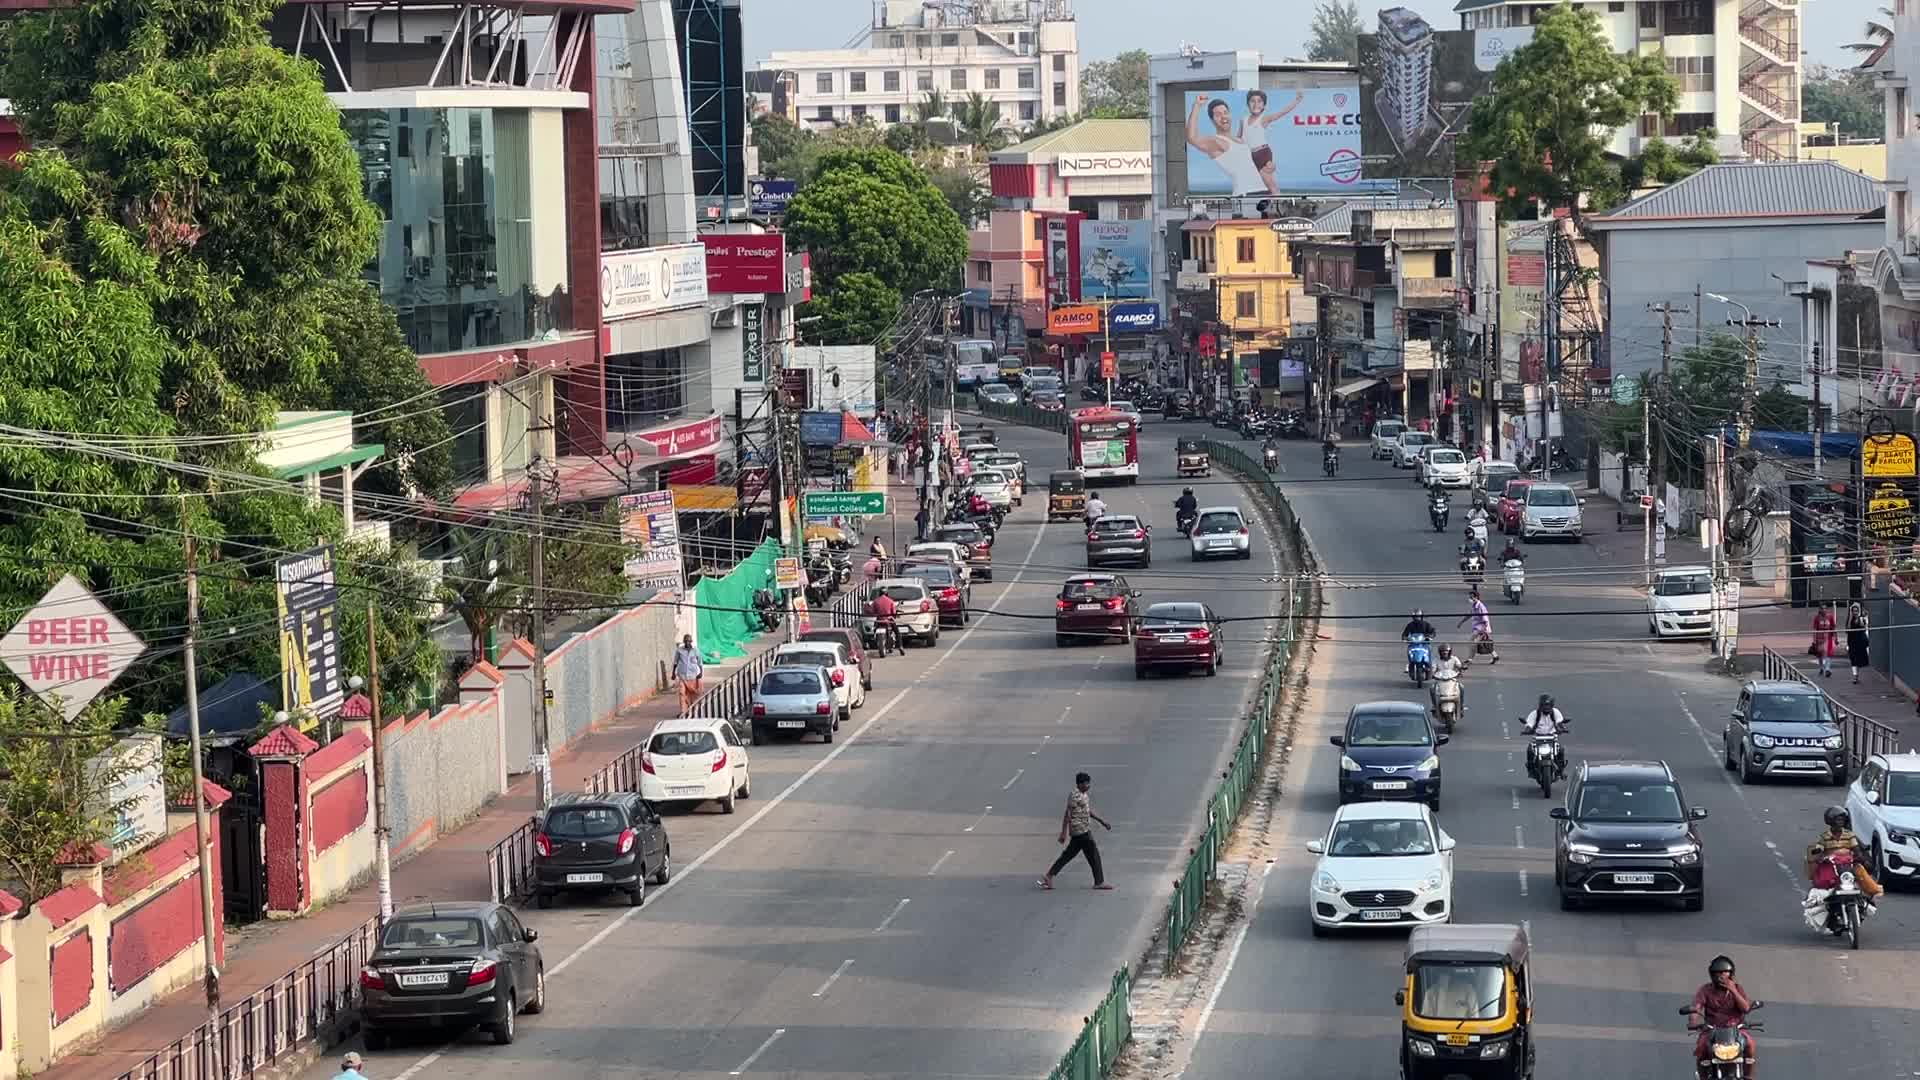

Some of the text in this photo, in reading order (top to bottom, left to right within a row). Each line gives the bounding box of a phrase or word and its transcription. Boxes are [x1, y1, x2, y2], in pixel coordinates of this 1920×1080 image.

[1294, 115, 1337, 125] LUX
[736, 247, 776, 258] Prestige
[1054, 313, 1094, 322] RAMCO
[1114, 313, 1156, 322] RAMCO
[747, 309, 758, 362] FABER
[809, 505, 867, 514] Medical College
[28, 618, 110, 645] BEER
[28, 654, 110, 681] WINE
